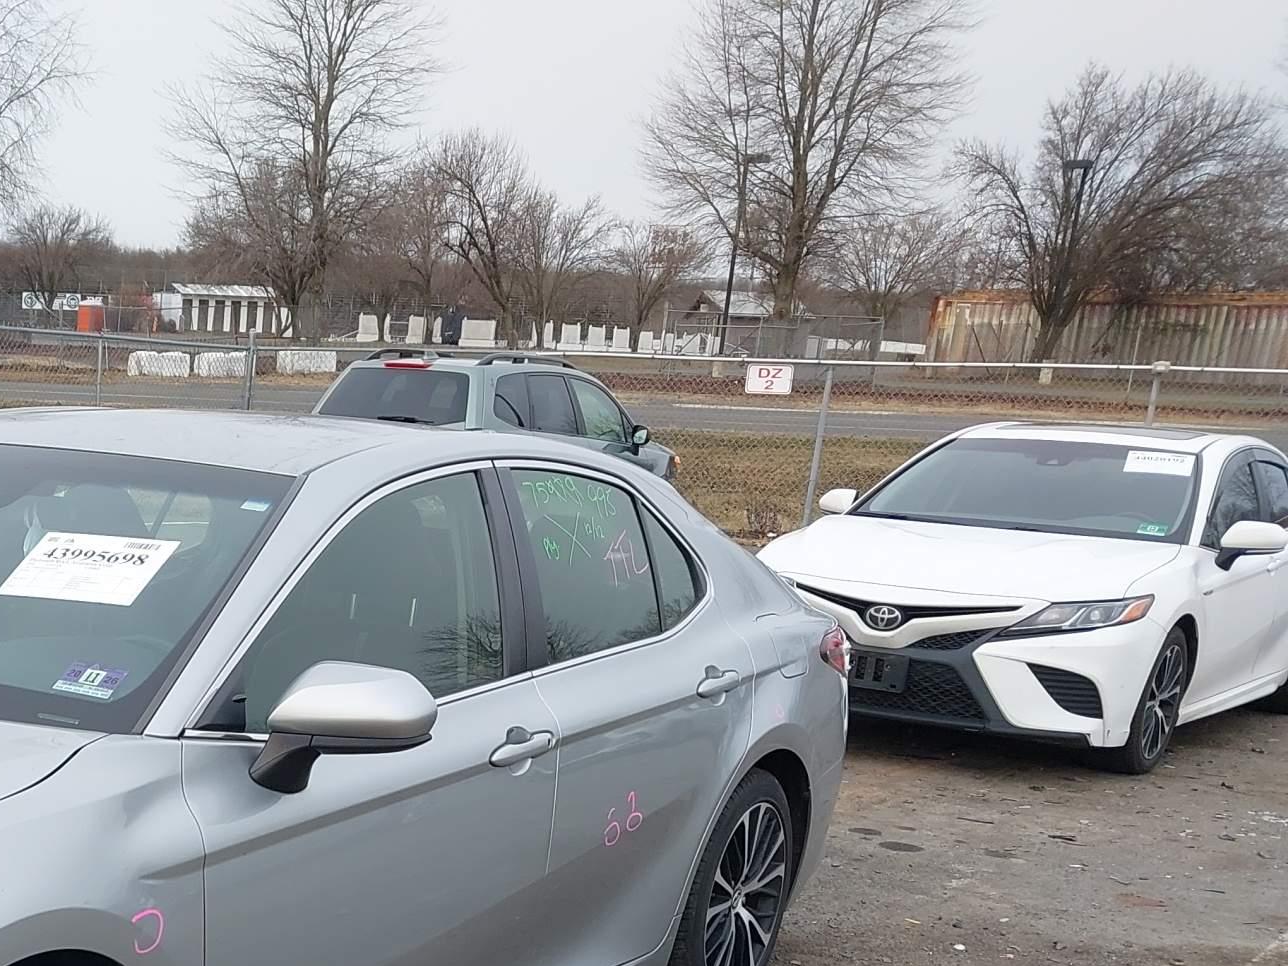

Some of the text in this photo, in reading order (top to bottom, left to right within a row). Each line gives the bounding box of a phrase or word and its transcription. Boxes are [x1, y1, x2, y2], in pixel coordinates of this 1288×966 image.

[758, 367, 784, 379] DZ
[764, 379, 774, 391] 2
[43, 547, 150, 566] 43995698
[66, 669, 82, 678] 20
[103, 676, 119, 685] 26
